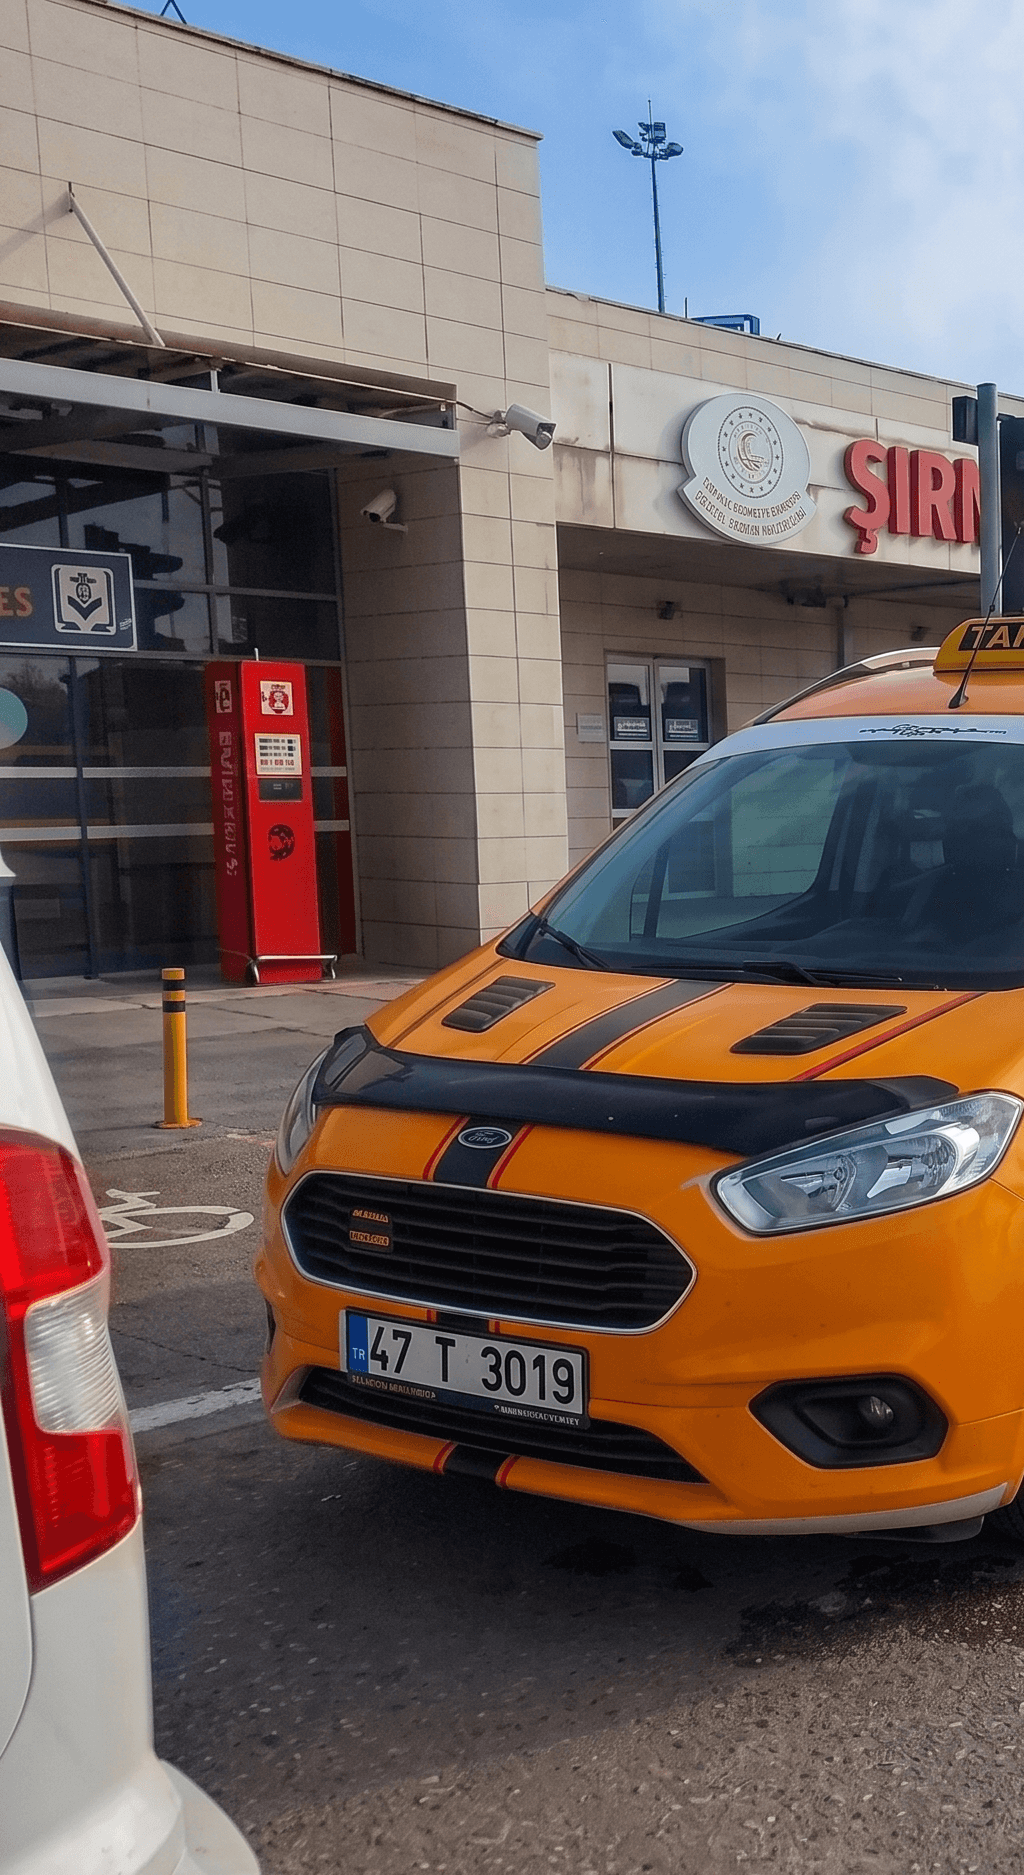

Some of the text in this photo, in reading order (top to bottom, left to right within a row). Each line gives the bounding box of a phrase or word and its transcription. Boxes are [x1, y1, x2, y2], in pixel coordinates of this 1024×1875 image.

[352, 1347, 366, 1361] TR
[370, 1326, 412, 1374] 47
[435, 1336, 456, 1383] T
[480, 1346, 574, 1405] 3019
